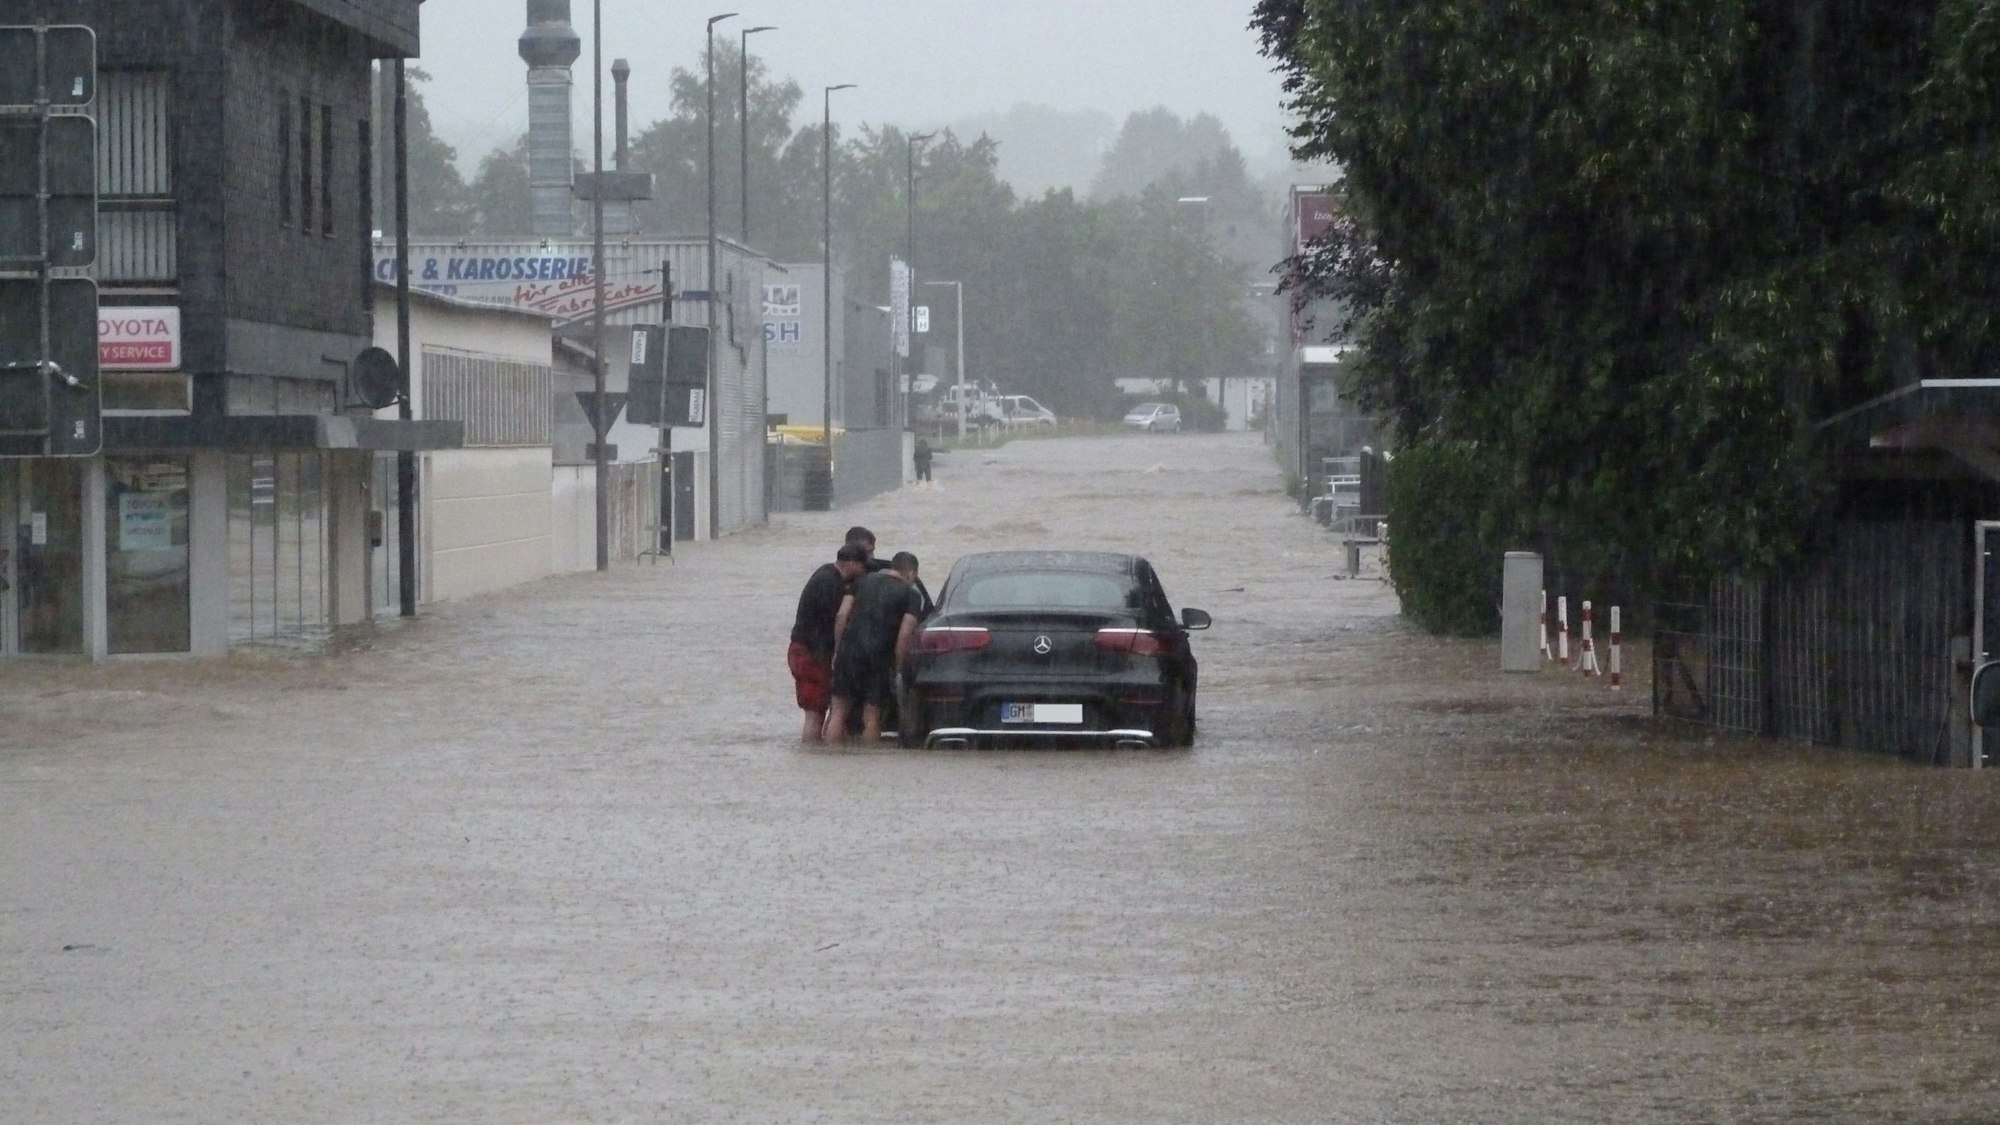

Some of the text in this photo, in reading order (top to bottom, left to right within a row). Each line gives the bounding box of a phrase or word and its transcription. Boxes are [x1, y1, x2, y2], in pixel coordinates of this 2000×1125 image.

[422, 257, 440, 280] &
[112, 346, 165, 358] SERVICE
[1010, 705, 1025, 718] GM
